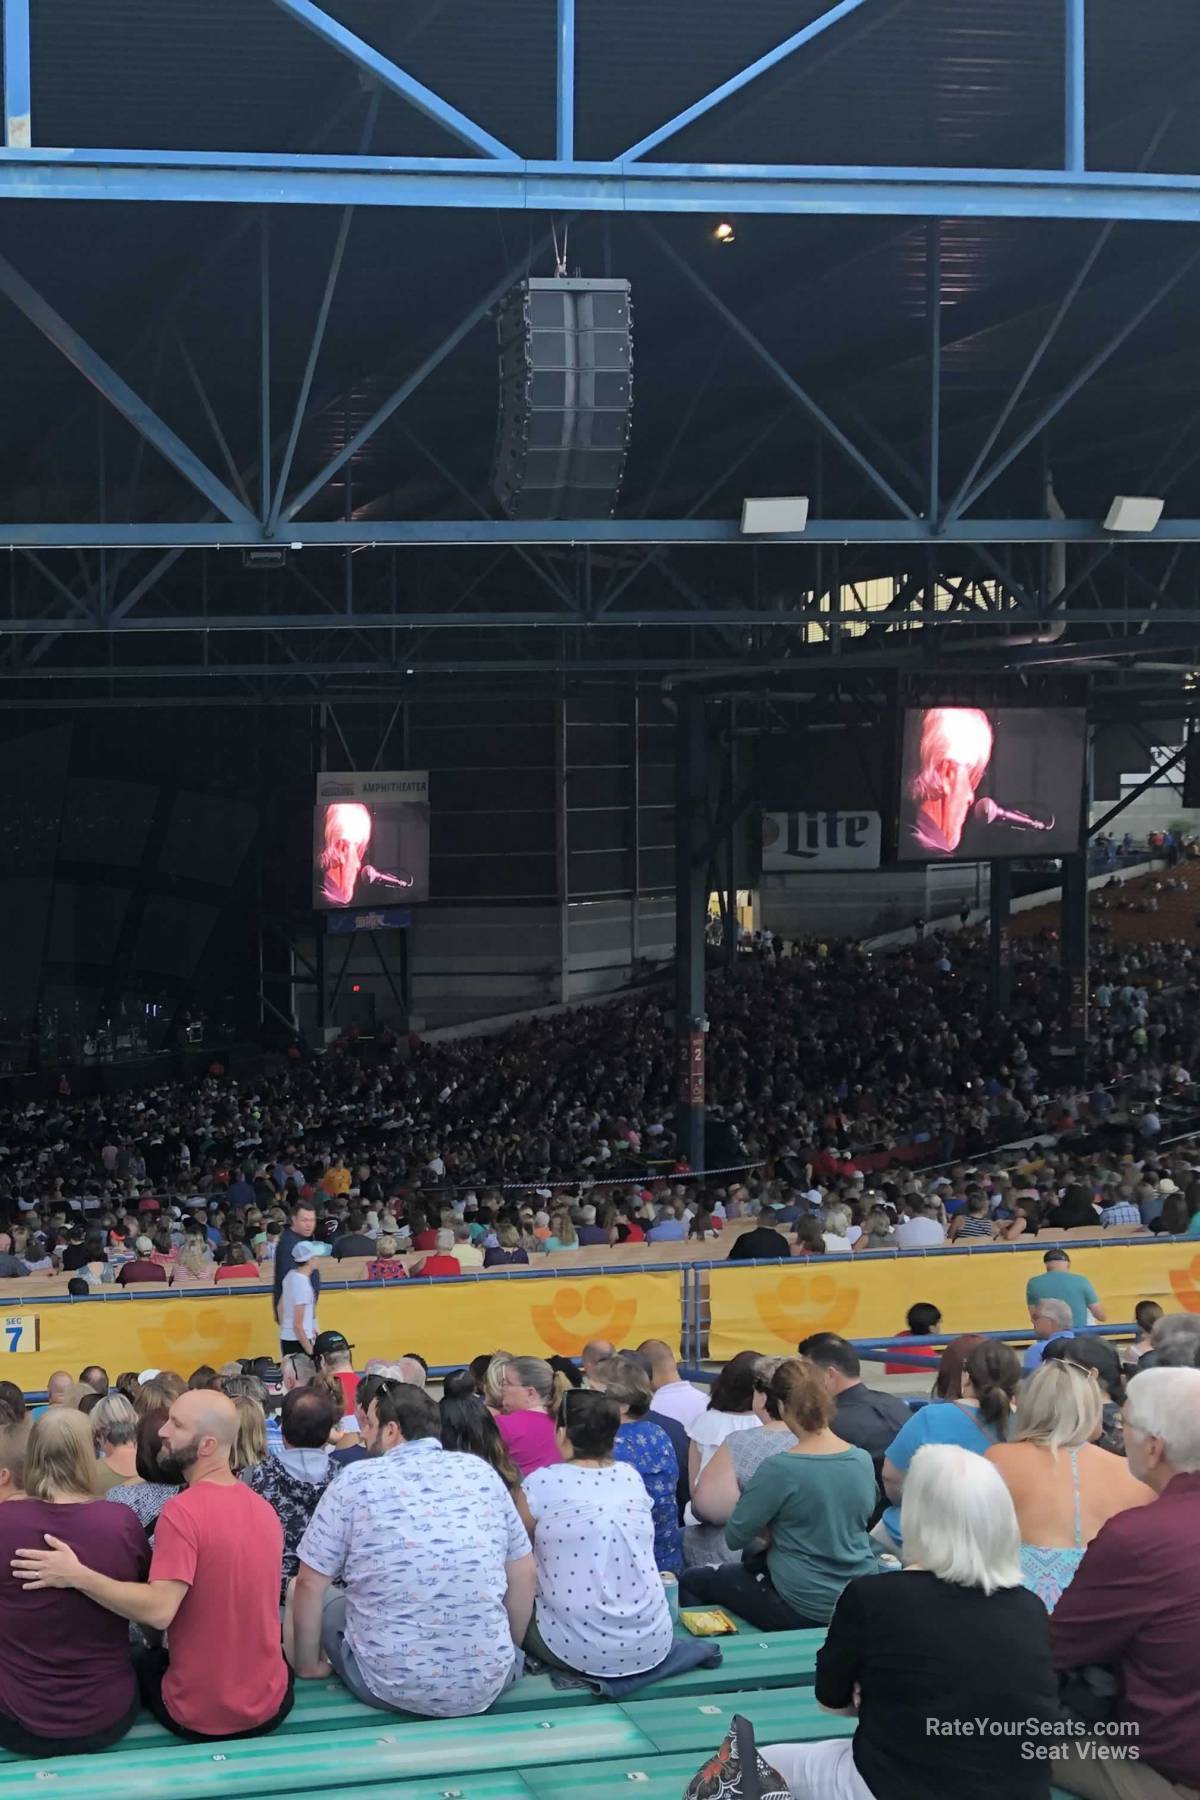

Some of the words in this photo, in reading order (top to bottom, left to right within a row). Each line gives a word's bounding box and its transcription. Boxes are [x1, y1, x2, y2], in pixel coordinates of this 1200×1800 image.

[362, 781, 426, 794] AMPHITHEATER
[783, 811, 870, 859] Lite
[694, 1048, 702, 1061] 2
[5, 1317, 22, 1325] SEC
[5, 1327, 23, 1352] 7
